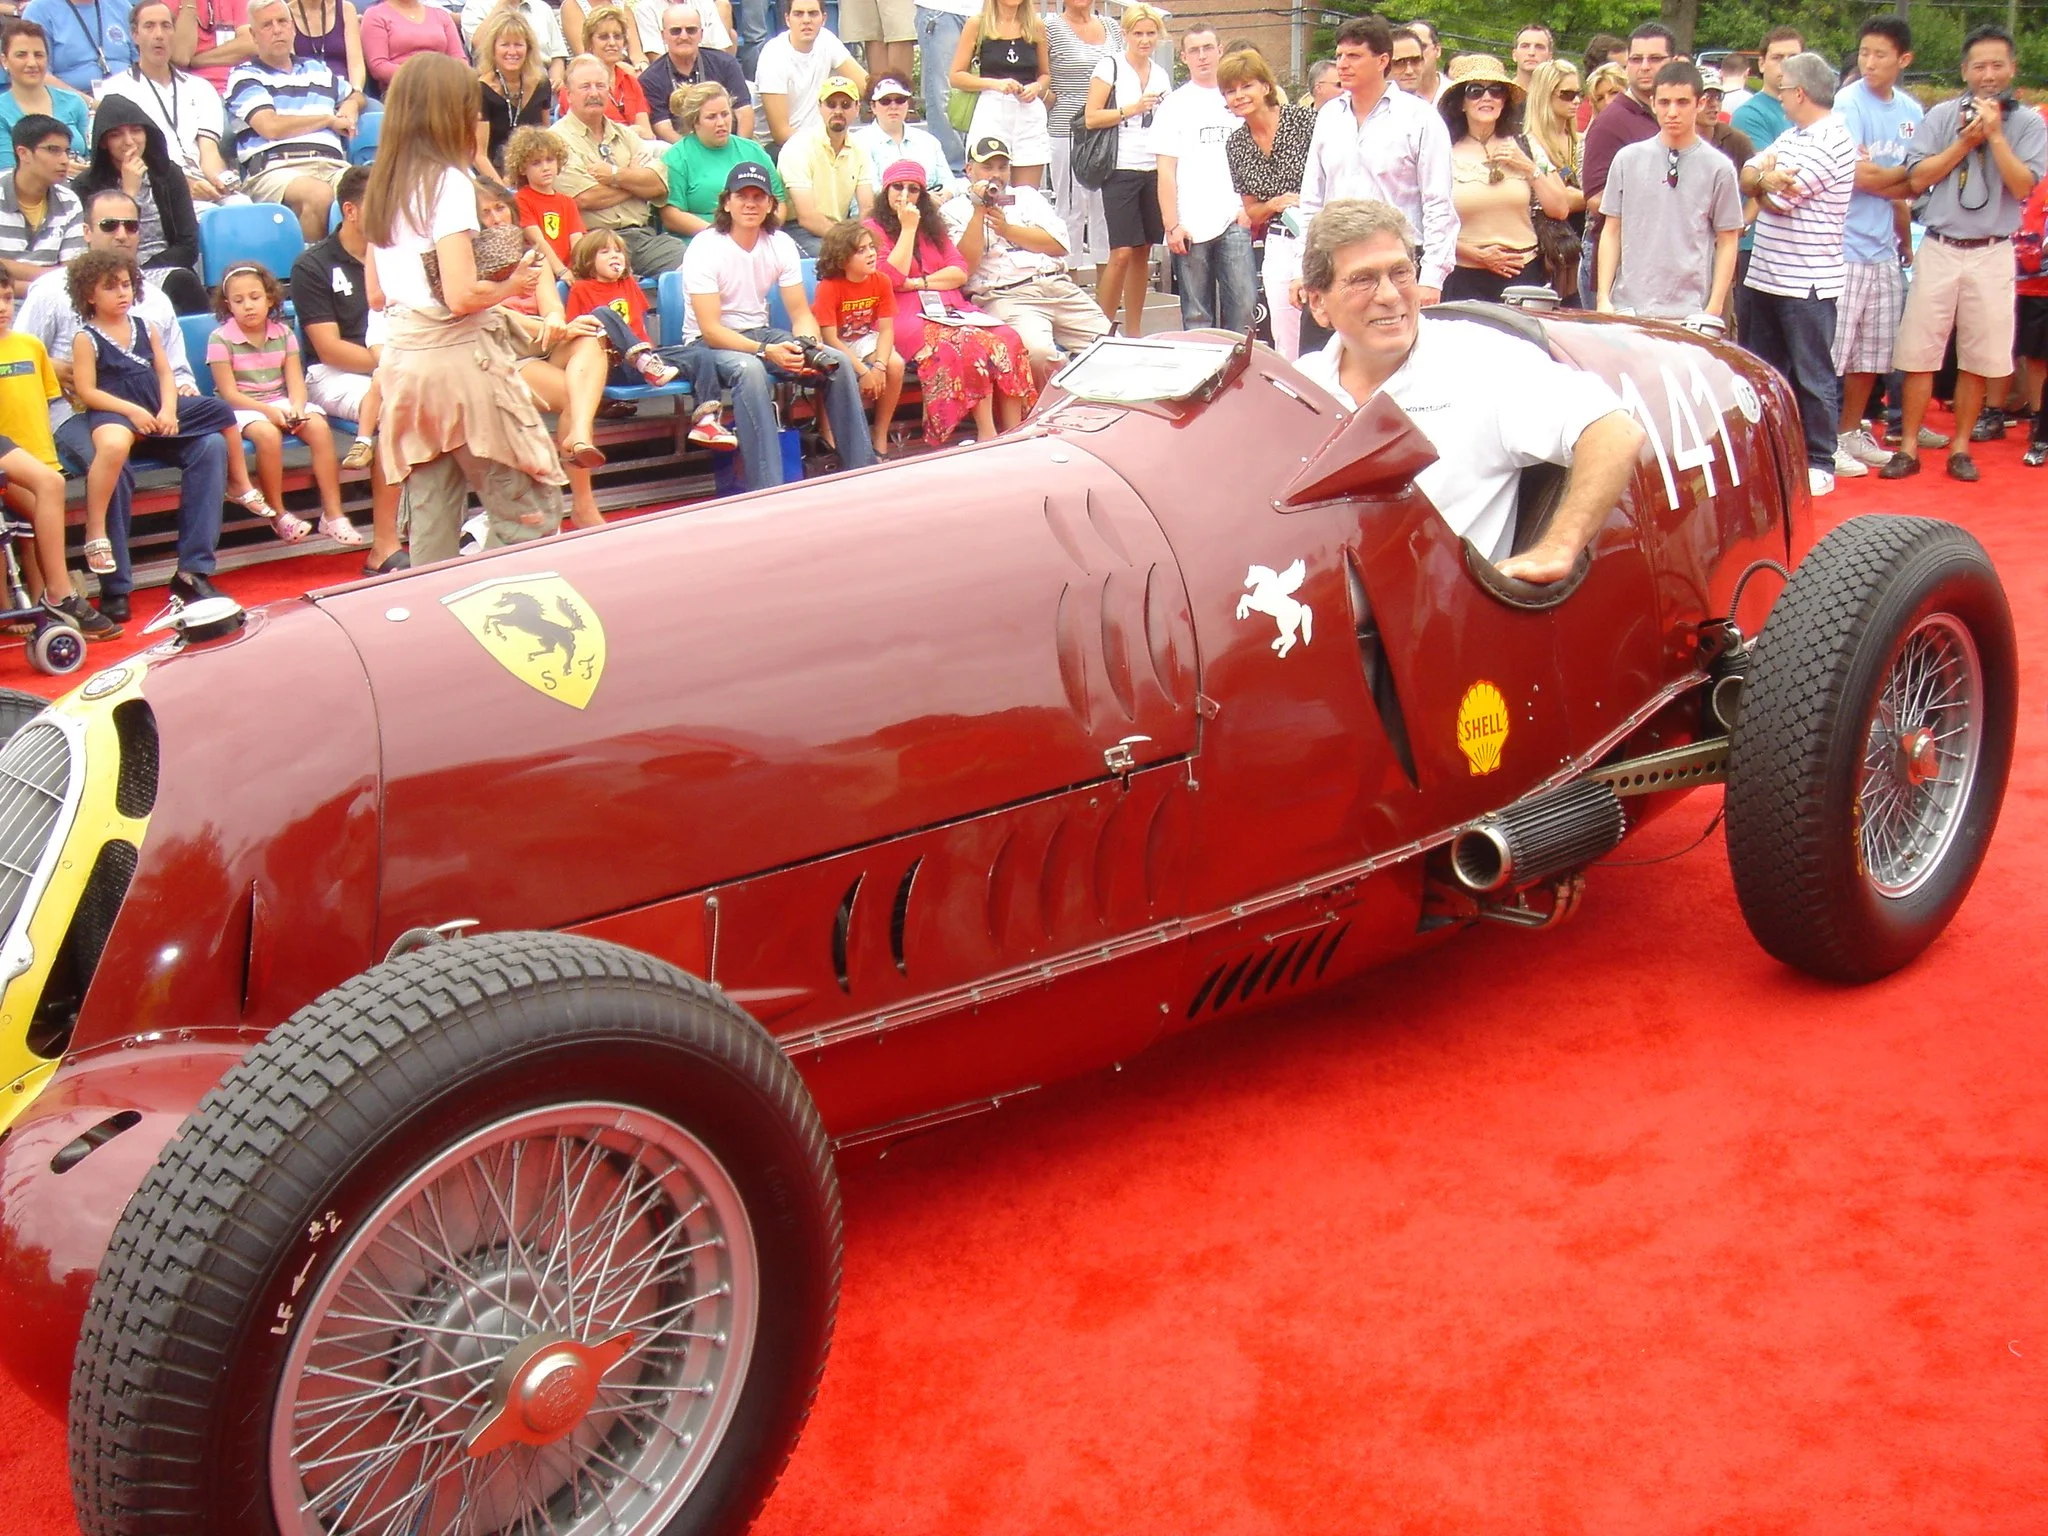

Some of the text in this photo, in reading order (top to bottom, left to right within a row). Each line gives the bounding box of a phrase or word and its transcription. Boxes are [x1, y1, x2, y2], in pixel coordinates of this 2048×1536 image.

[332, 266, 353, 297] 4
[1619, 360, 1740, 510] 141
[541, 654, 595, 690] S F
[1464, 713, 1503, 741] SHELL
[270, 1302, 294, 1335] LF
